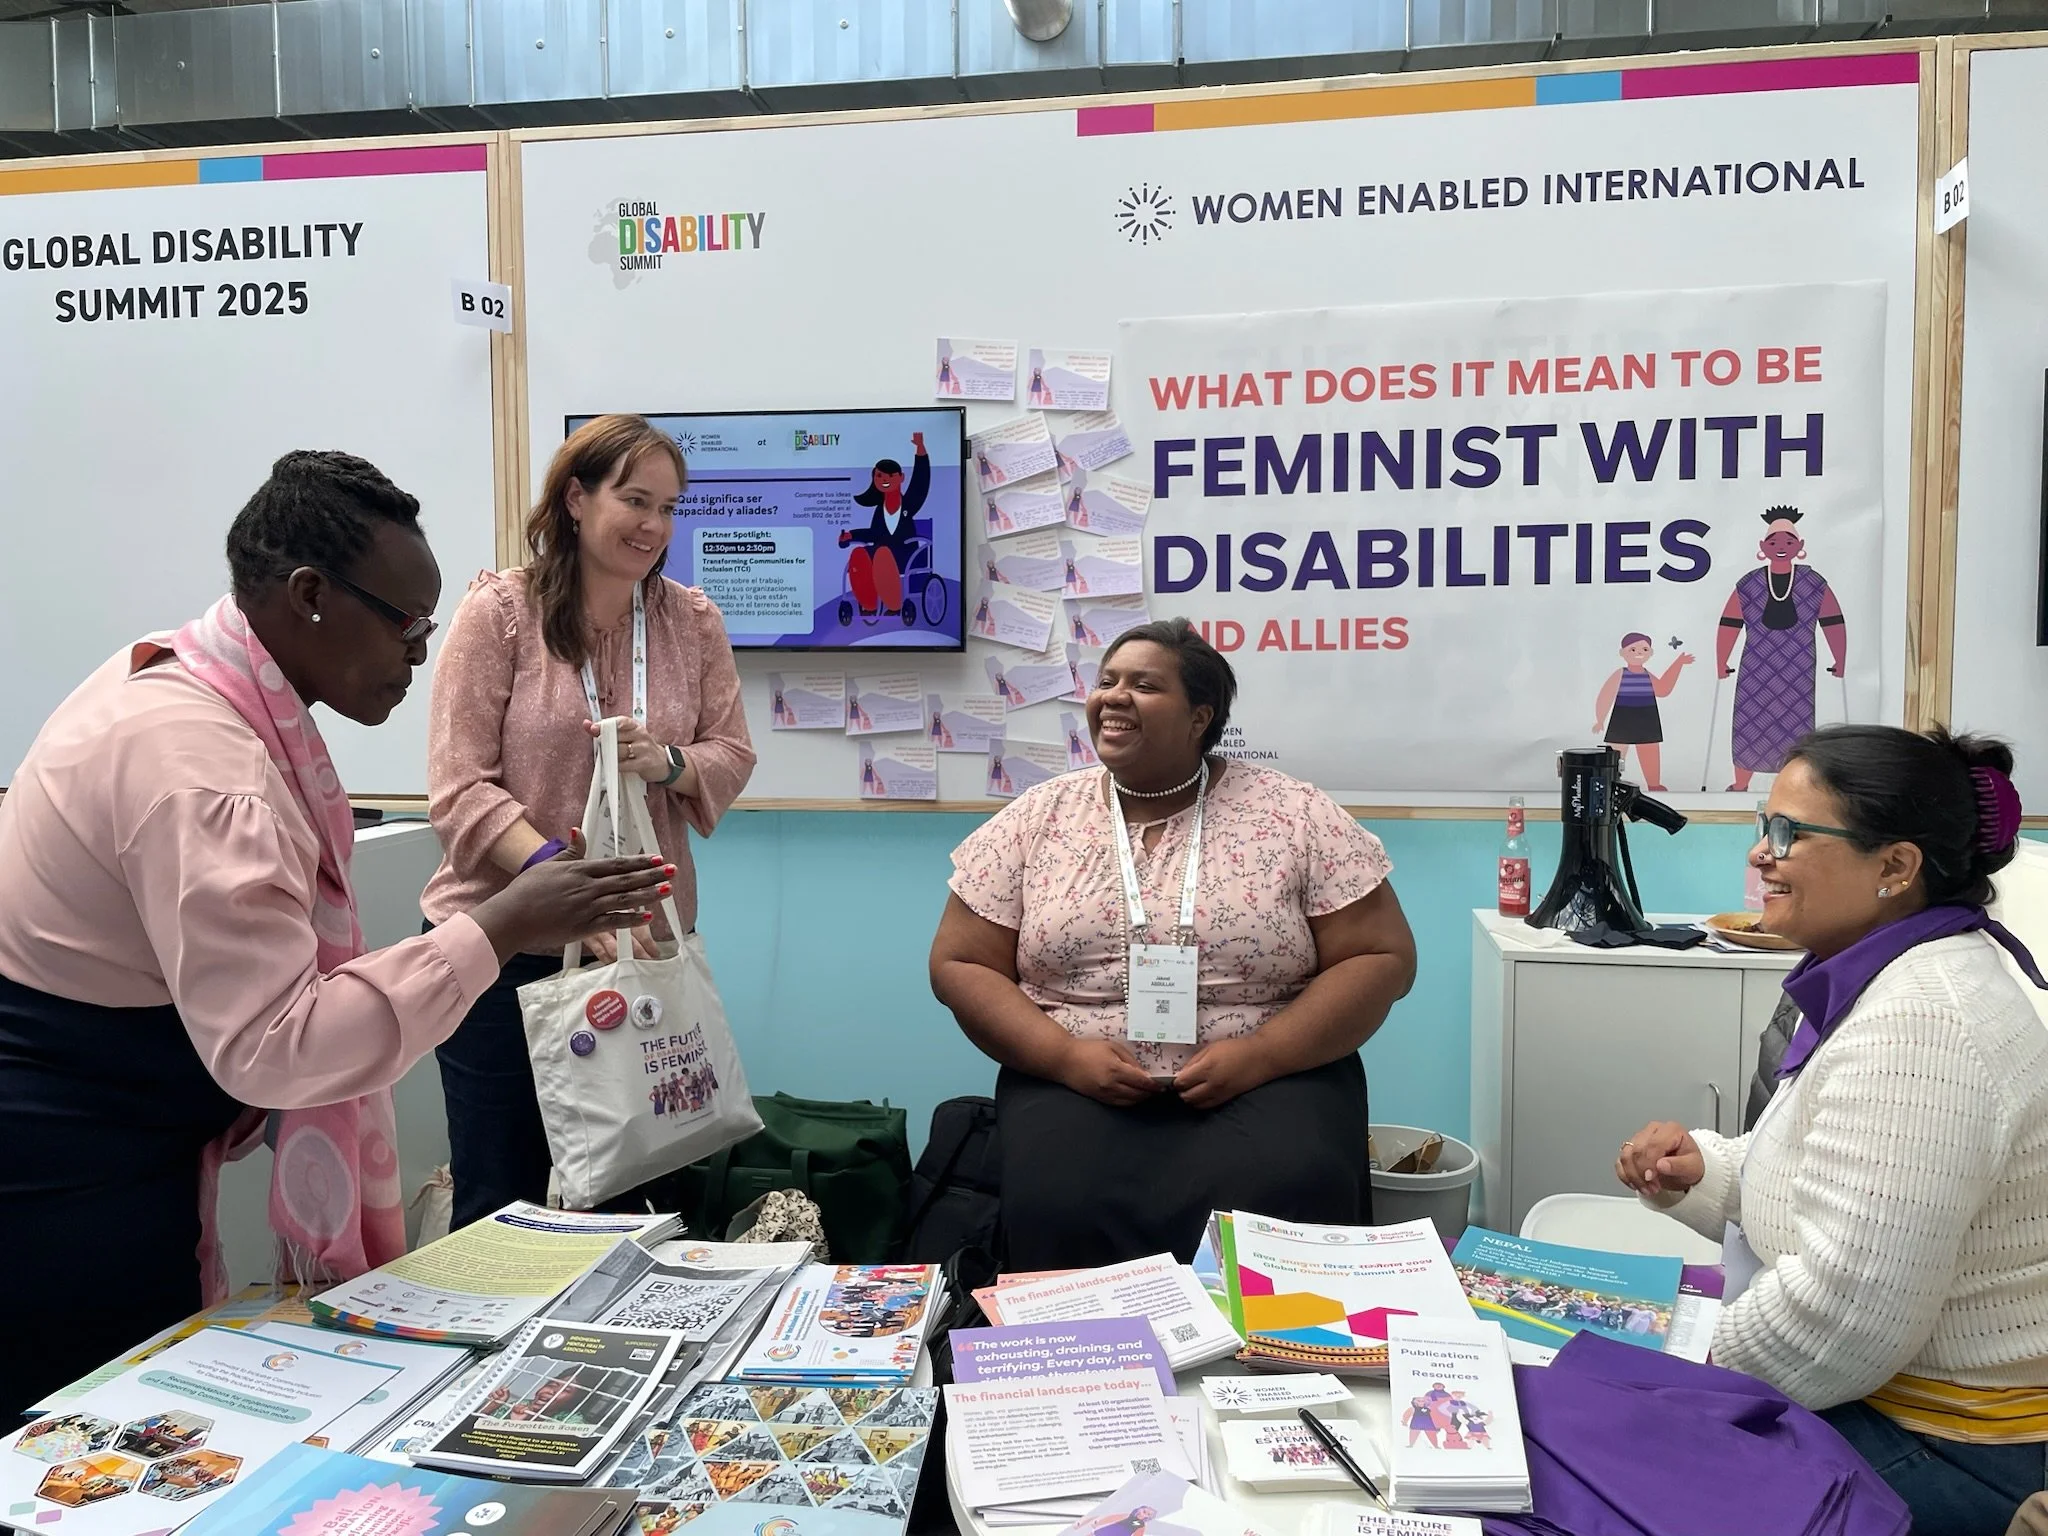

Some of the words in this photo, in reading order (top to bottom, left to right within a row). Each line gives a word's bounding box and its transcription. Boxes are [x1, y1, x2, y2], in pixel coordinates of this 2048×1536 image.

[1192, 187, 1342, 225] WOMEN
[1358, 177, 1528, 216] ENABLED
[1544, 157, 1865, 205] INTERNATIONAL
[1944, 191, 1951, 214] B
[1953, 180, 1965, 207] 02
[618, 202, 660, 218] GLOBAL
[619, 212, 766, 255] DISABILITY
[2, 233, 141, 271] GLOBAL
[153, 222, 364, 263] DISABILITY
[620, 255, 663, 271] SUMMIT
[55, 286, 205, 323] SUMMIT
[218, 281, 309, 317] 2025
[461, 292, 475, 311] B
[481, 296, 504, 319] 02
[1149, 371, 1292, 411] WHAT
[1305, 363, 1437, 405] DOES
[1452, 361, 1495, 398] IT
[1508, 353, 1656, 396] MEAN
[1671, 349, 1741, 387] TO
[1757, 346, 1822, 384] BE
[757, 438, 767, 446] at
[795, 434, 840, 447] DISABILITY
[1154, 424, 1558, 499] FEMINIST
[1579, 413, 1824, 484] WITH
[701, 493, 743, 506] significa
[746, 495, 763, 503] ser
[672, 506, 724, 516] capacidad
[728, 508, 734, 517] y
[736, 506, 778, 516] aliades?
[702, 531, 730, 539] Partner
[733, 531, 772, 540] Spotlight:
[705, 544, 736, 553] 12:30pm
[747, 544, 774, 553] 2:30pm
[1154, 519, 1713, 594] DISABILITIES
[703, 558, 748, 566] Transforming
[734, 565, 751, 573] (TCI)
[745, 585, 797, 593] organizaciones
[760, 577, 784, 586] trabajo
[1186, 620, 1245, 653] ND
[1257, 617, 1409, 652] ALLIES
[1221, 727, 1242, 736] MEN
[1216, 739, 1246, 748] ABLED
[640, 1037, 666, 1053] THE
[644, 1061, 659, 1074] IS
[1483, 1236, 1533, 1253] NEPAL
[1263, 1261, 1297, 1273] Global
[1300, 1266, 1350, 1277] Disability
[1353, 1268, 1396, 1277] Summit
[1399, 1266, 1427, 1274] 2025
[1005, 1295, 1027, 1306] The
[1027, 1281, 1075, 1300] financial
[1075, 1271, 1130, 1290] landscape
[973, 1340, 998, 1351] The
[1000, 1337, 1033, 1348] work
[1036, 1335, 1046, 1345] is
[1048, 1334, 1077, 1344] now
[975, 1348, 1054, 1363] exhausting,
[1055, 1343, 1114, 1357] draining,
[1116, 1339, 1143, 1350] and
[1401, 1348, 1480, 1361] Publications
[977, 1359, 1043, 1375] terrifying.
[1047, 1356, 1083, 1370] Every
[1086, 1353, 1116, 1366] day,
[1118, 1352, 1153, 1363] more
[1412, 1370, 1480, 1381] Resources
[145, 1376, 160, 1384] and
[159, 1380, 198, 1395] supporting
[197, 1391, 236, 1407] Community
[237, 1402, 270, 1415] Inclusion
[270, 1410, 297, 1421] models
[167, 1374, 231, 1399] Recommendations
[242, 1397, 289, 1413] implementing
[953, 1393, 977, 1404] The
[979, 1388, 1034, 1402] financial
[1036, 1383, 1100, 1399] landscape
[1259, 1393, 1321, 1402] INTERNATIONAL
[481, 1420, 501, 1428] The
[503, 1421, 556, 1431] Forgotten
[558, 1424, 589, 1432] Women
[1280, 1424, 1333, 1432] FUTO
[1255, 1437, 1272, 1445] ES
[323, 1508, 354, 1529] Bali
[1358, 1514, 1387, 1524] THE
[1391, 1518, 1452, 1531] FUTURE
[1358, 1525, 1372, 1534] IS
